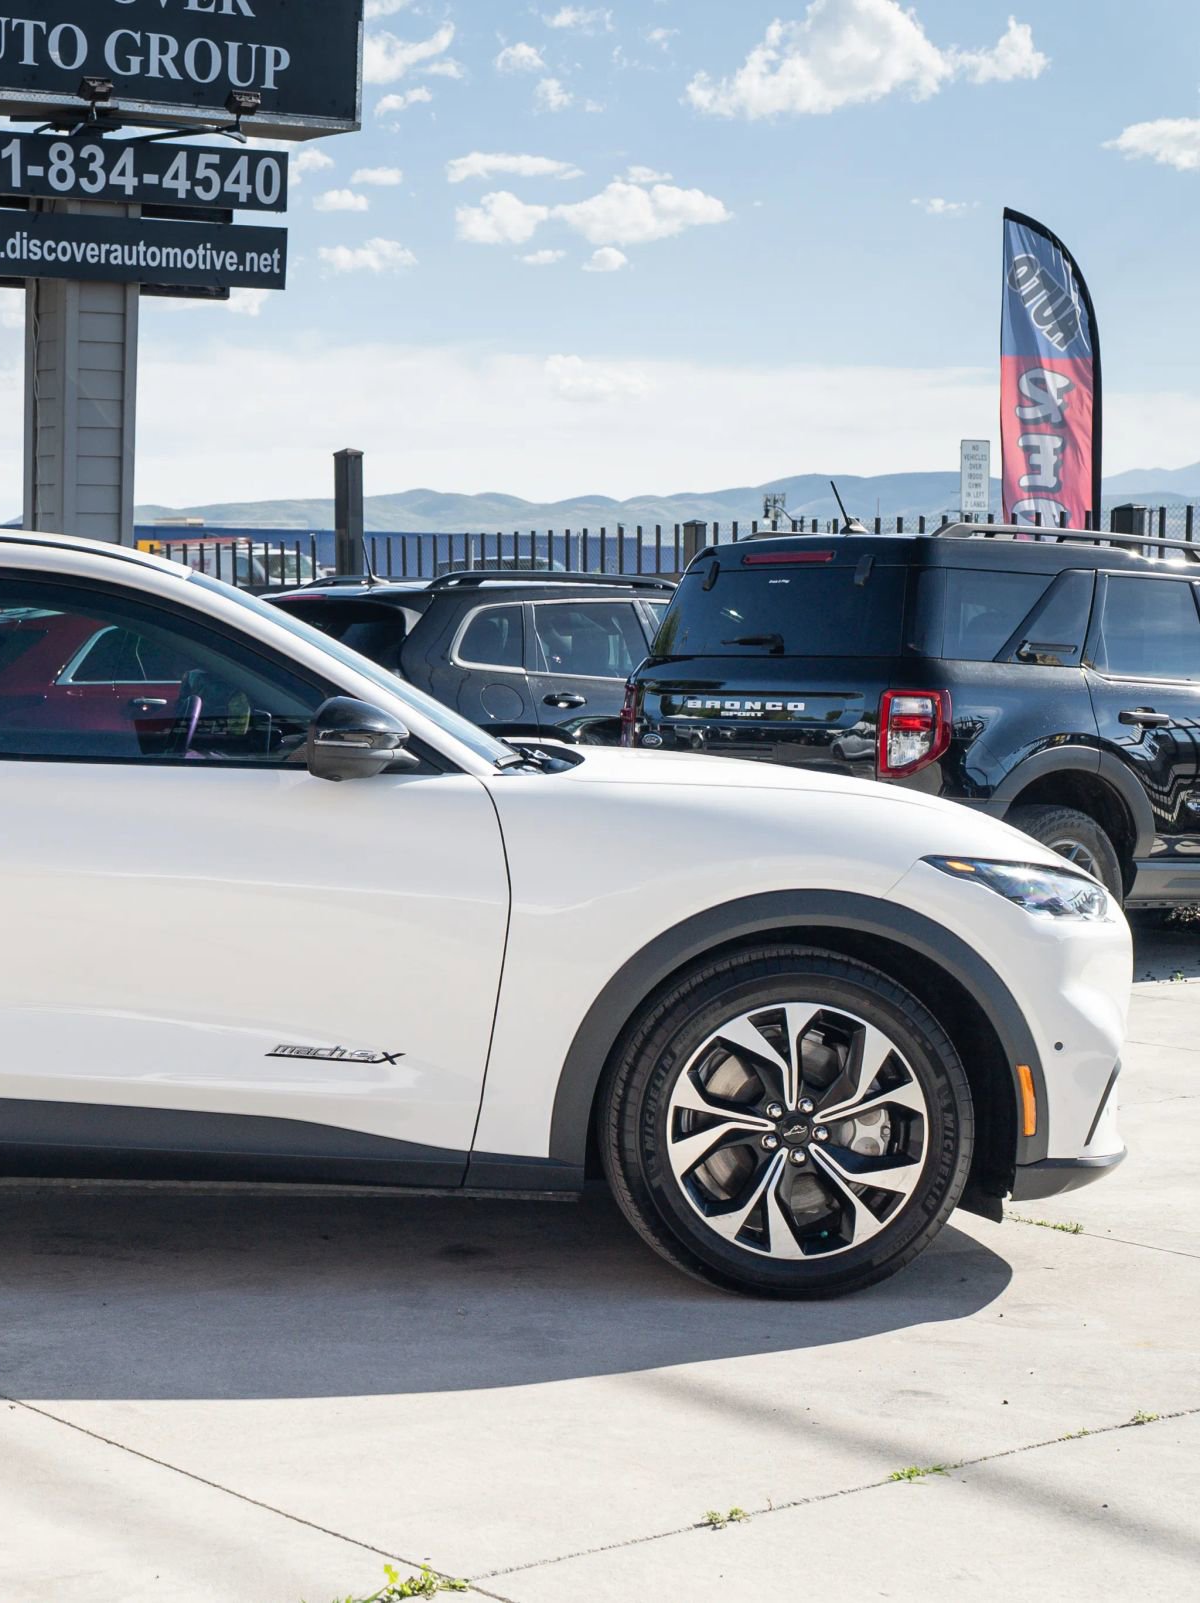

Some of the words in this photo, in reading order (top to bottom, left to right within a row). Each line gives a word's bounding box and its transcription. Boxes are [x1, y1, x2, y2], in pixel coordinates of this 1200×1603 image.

[103, 29, 291, 90] GROUP
[971, 444, 980, 452] NO
[687, 700, 805, 711] BRONCO
[643, 1054, 674, 1152] MICHELIN
[924, 1111, 955, 1210] MICHELIN
